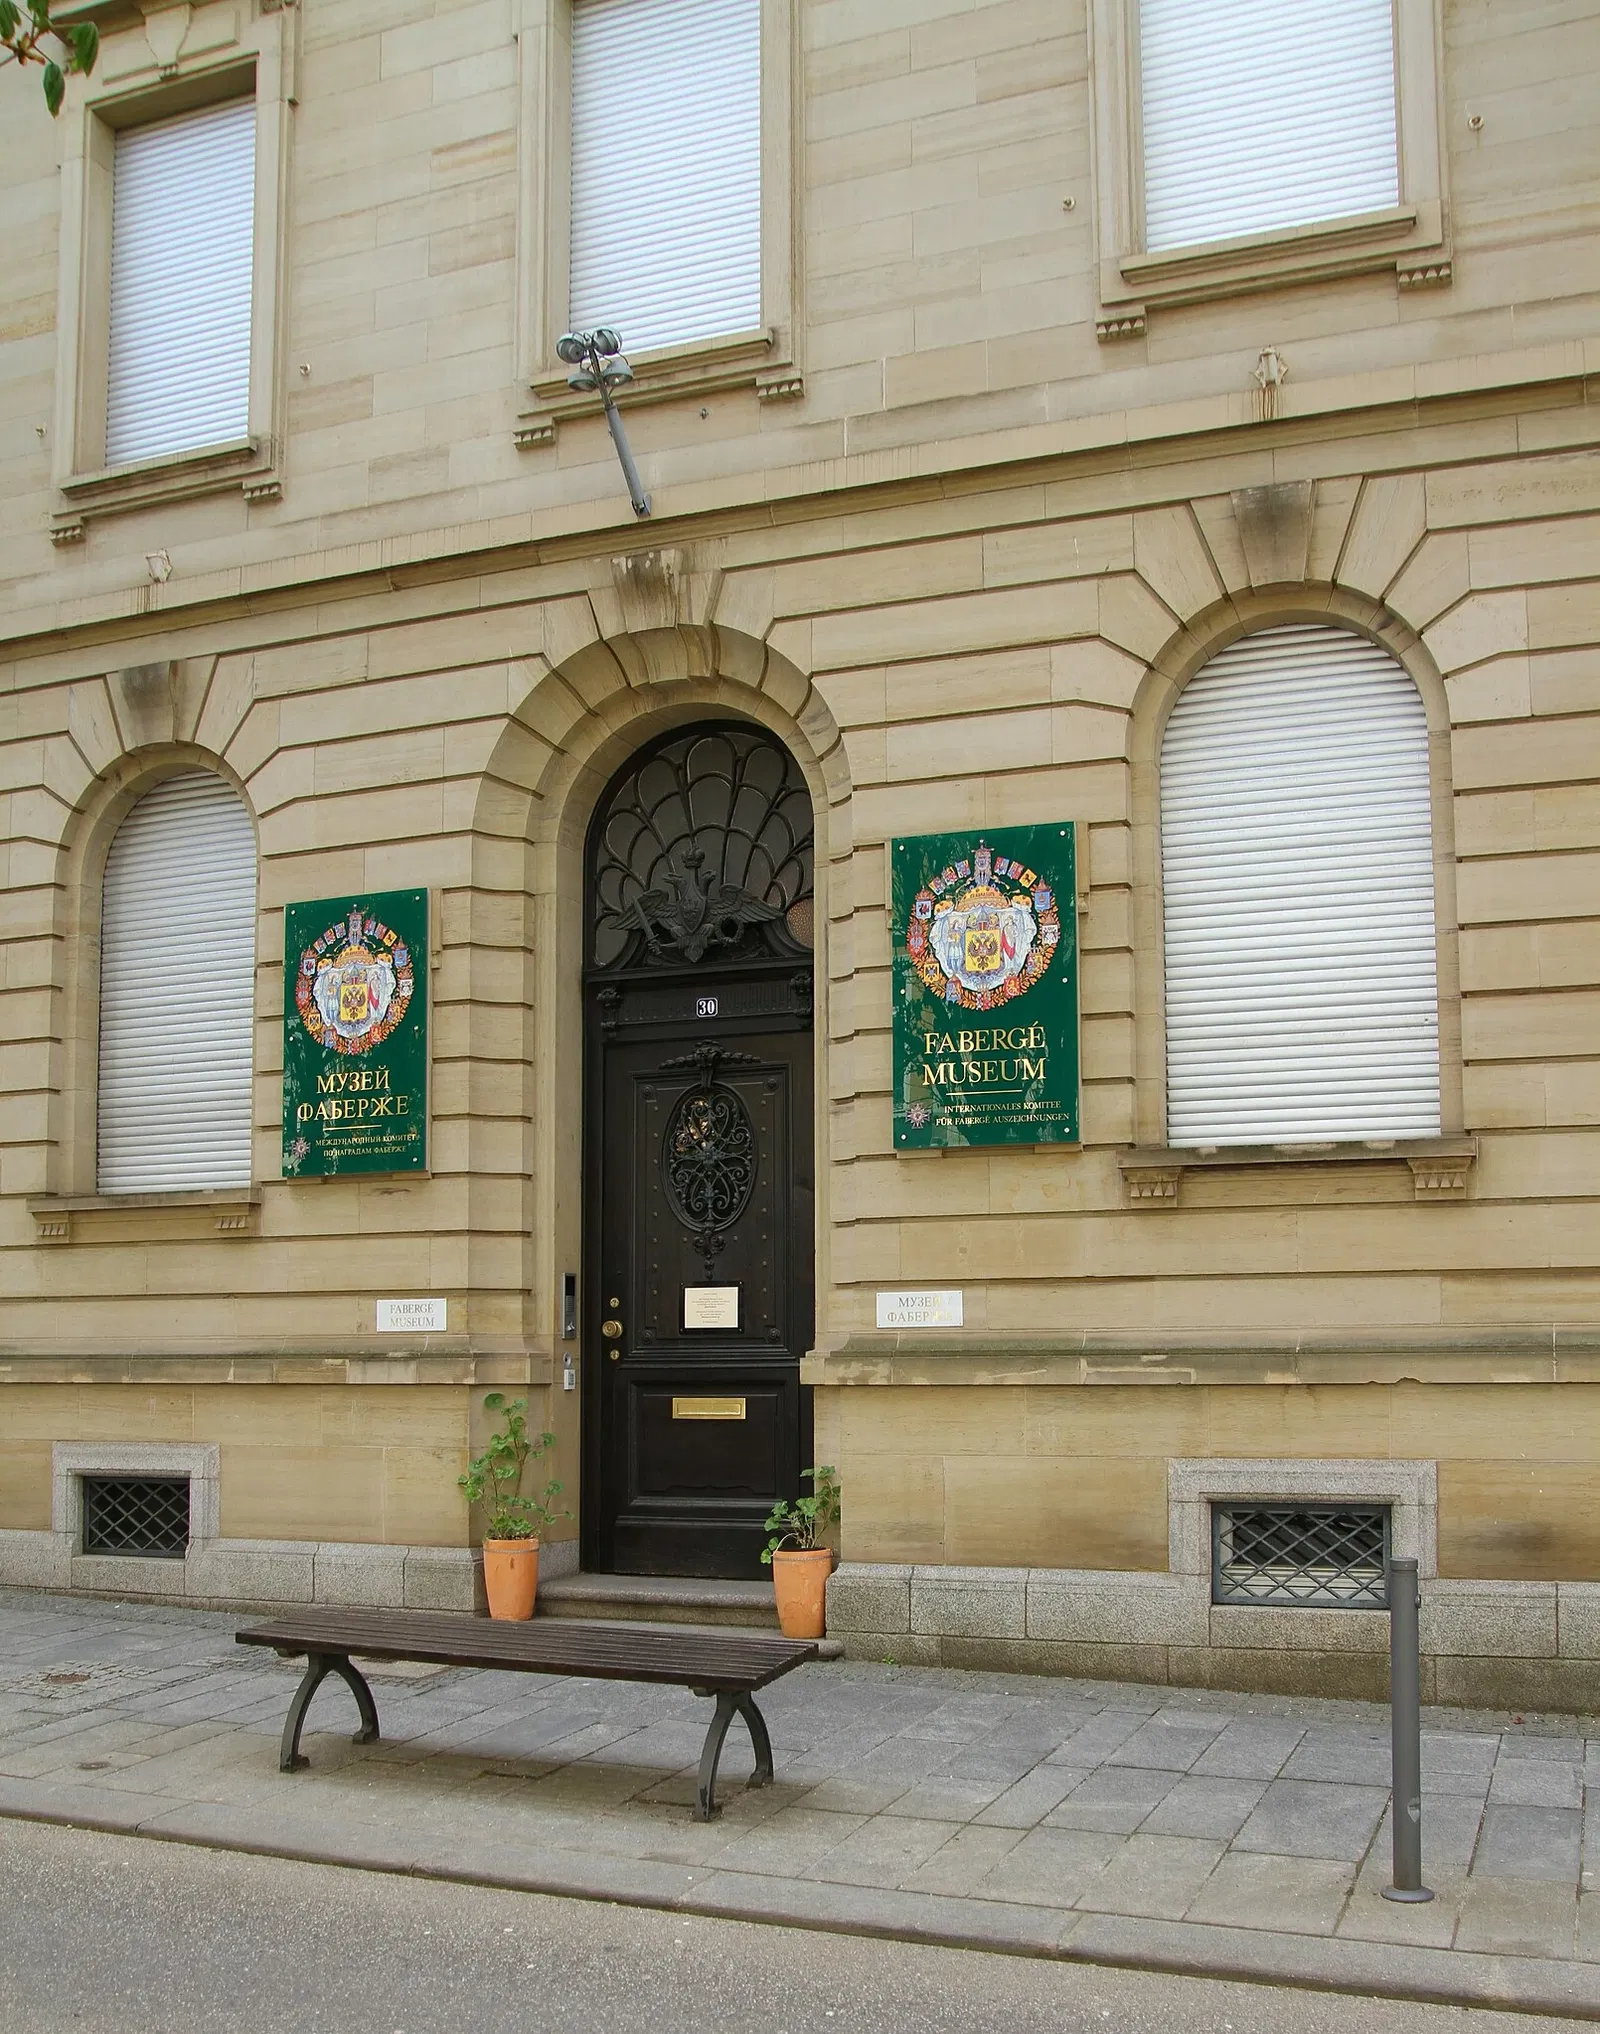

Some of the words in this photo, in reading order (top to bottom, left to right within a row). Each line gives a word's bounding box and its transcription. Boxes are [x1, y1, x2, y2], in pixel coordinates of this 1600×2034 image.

[699, 1000, 715, 1015] 30
[923, 1020, 1046, 1055] FABERGÉ
[922, 1057, 1047, 1086] MUSEUM
[316, 1065, 390, 1094] МУЗЕЙ
[297, 1095, 409, 1122] ФАБЕРЖЕ
[944, 1102, 1021, 1114] INTERNATIONALES
[1023, 1100, 1061, 1110] KOMITEE
[935, 1116, 953, 1126] FÜR
[954, 1115, 990, 1125] FABERGÉ
[993, 1113, 1070, 1123] AUSZEICHNUNGEN
[383, 1134, 416, 1142] КОМИТЕТ
[390, 1301, 434, 1314] FABERGÉ
[390, 1316, 435, 1327] MUSEUM
